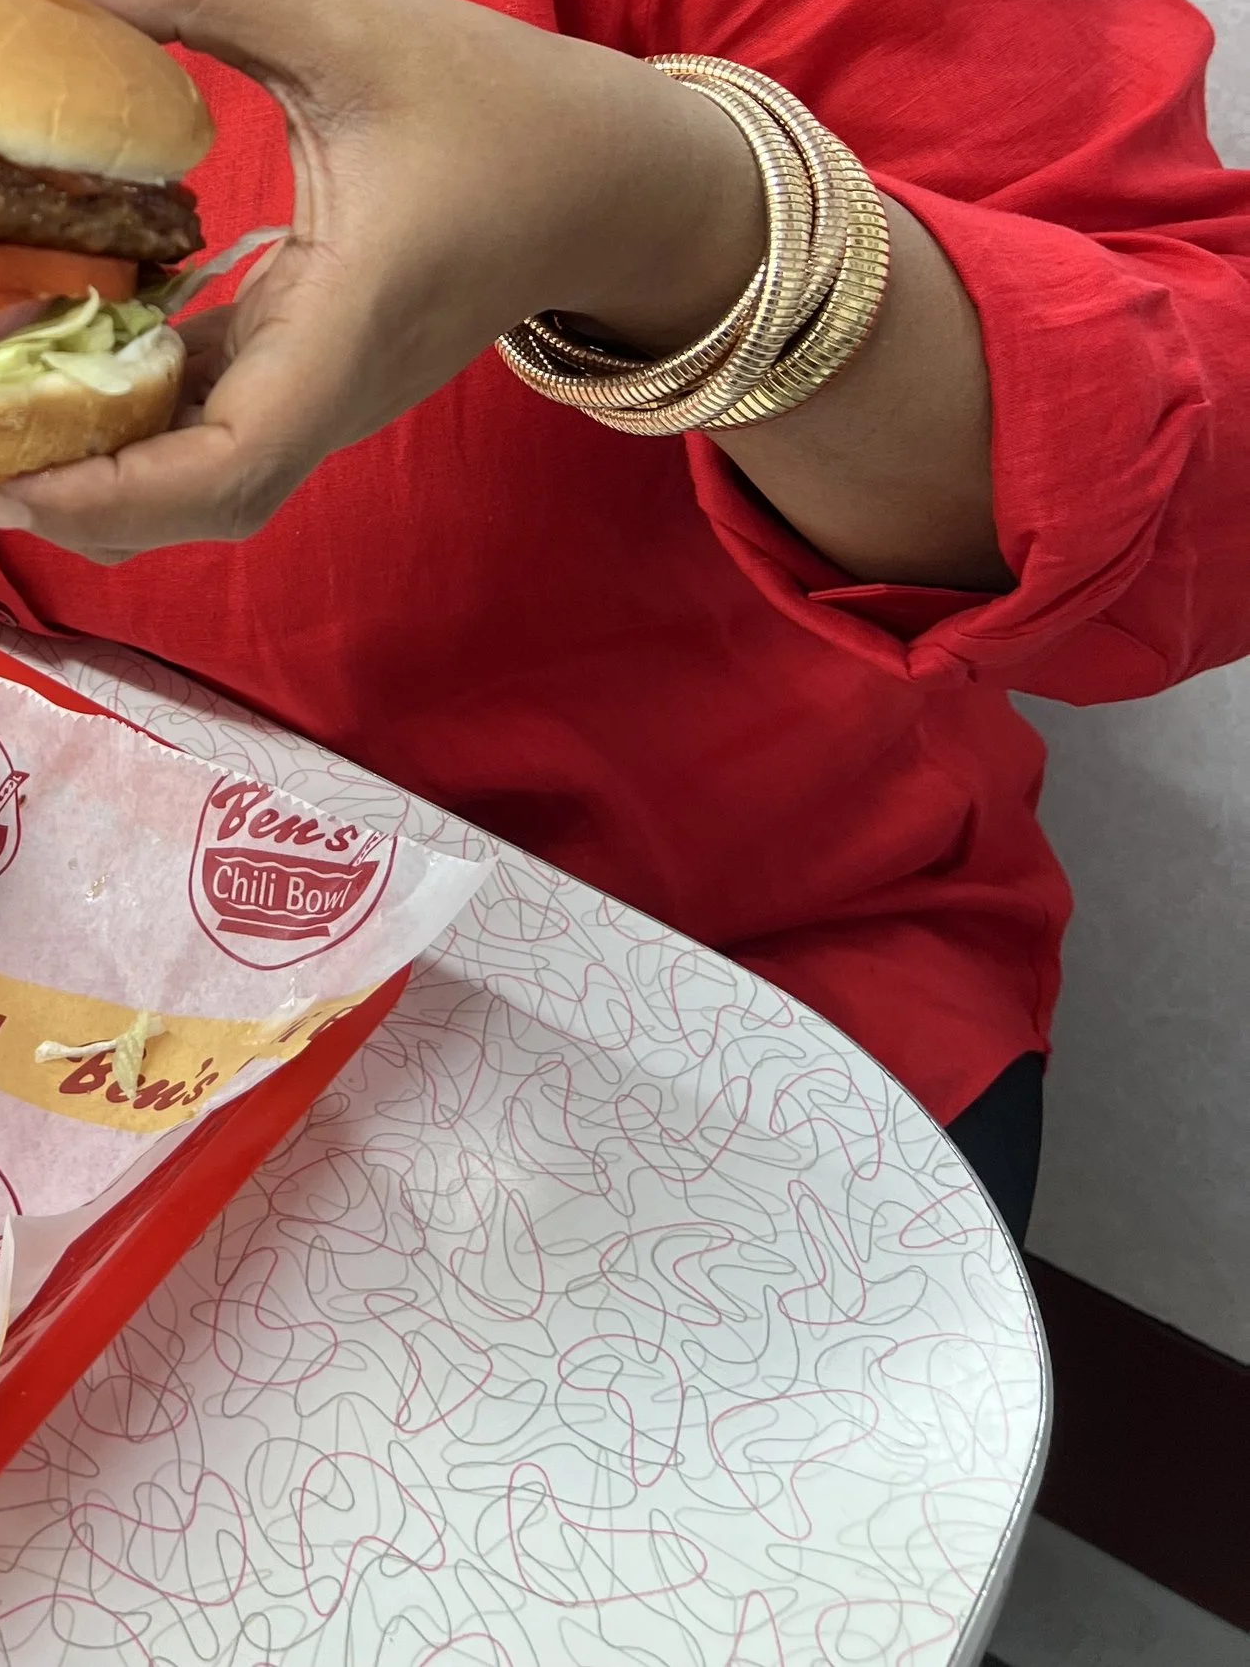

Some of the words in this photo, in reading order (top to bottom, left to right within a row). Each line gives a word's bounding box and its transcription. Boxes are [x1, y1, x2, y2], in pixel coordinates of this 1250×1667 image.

[210, 779, 360, 853] Ben's
[213, 865, 278, 908] Chili
[286, 875, 354, 914] Bowl
